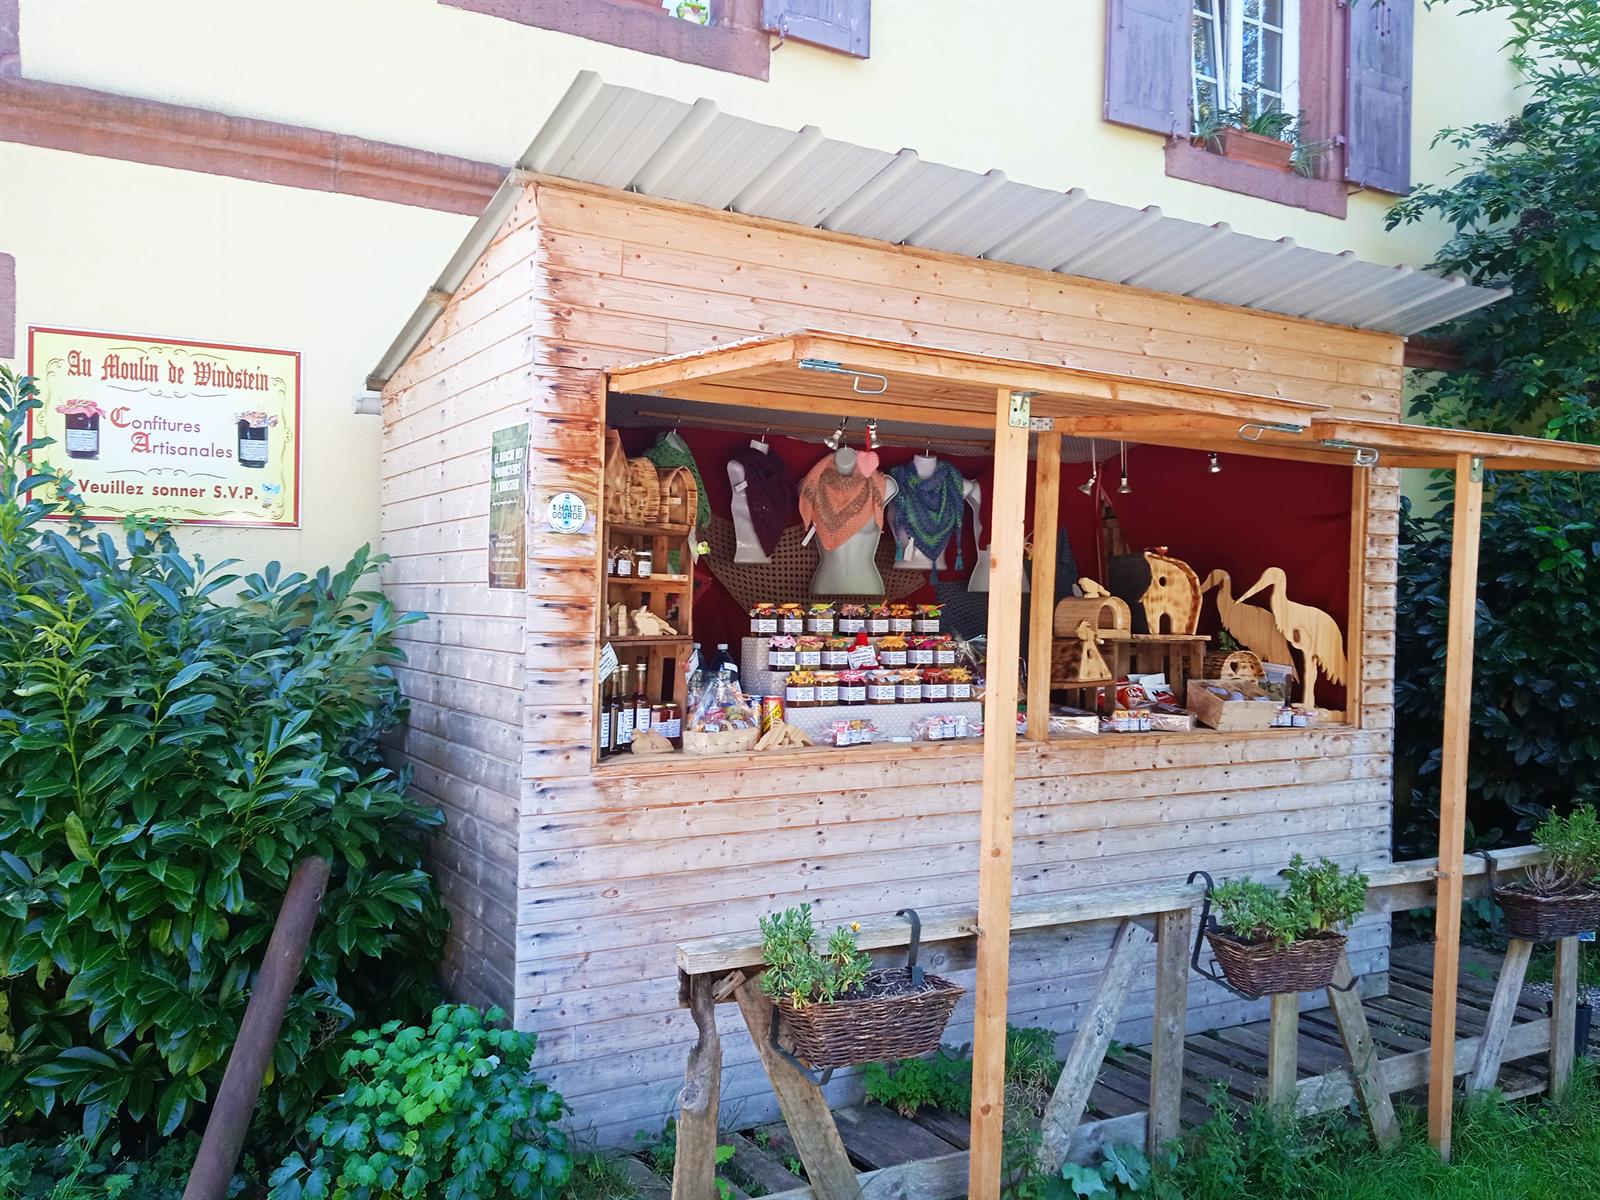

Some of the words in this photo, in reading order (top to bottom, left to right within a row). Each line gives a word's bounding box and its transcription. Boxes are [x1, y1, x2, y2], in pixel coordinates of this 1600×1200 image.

[67, 350, 92, 377] Au
[100, 354, 159, 382] Moulin
[167, 360, 185, 385] de
[193, 360, 269, 391] Windstein
[110, 406, 201, 433] Confitures
[131, 431, 233, 459] Artisanales
[78, 479, 144, 495] Veuillez
[152, 485, 206, 498] sonner
[213, 485, 259, 500] S.V.P.
[558, 504, 582, 512] HALTE
